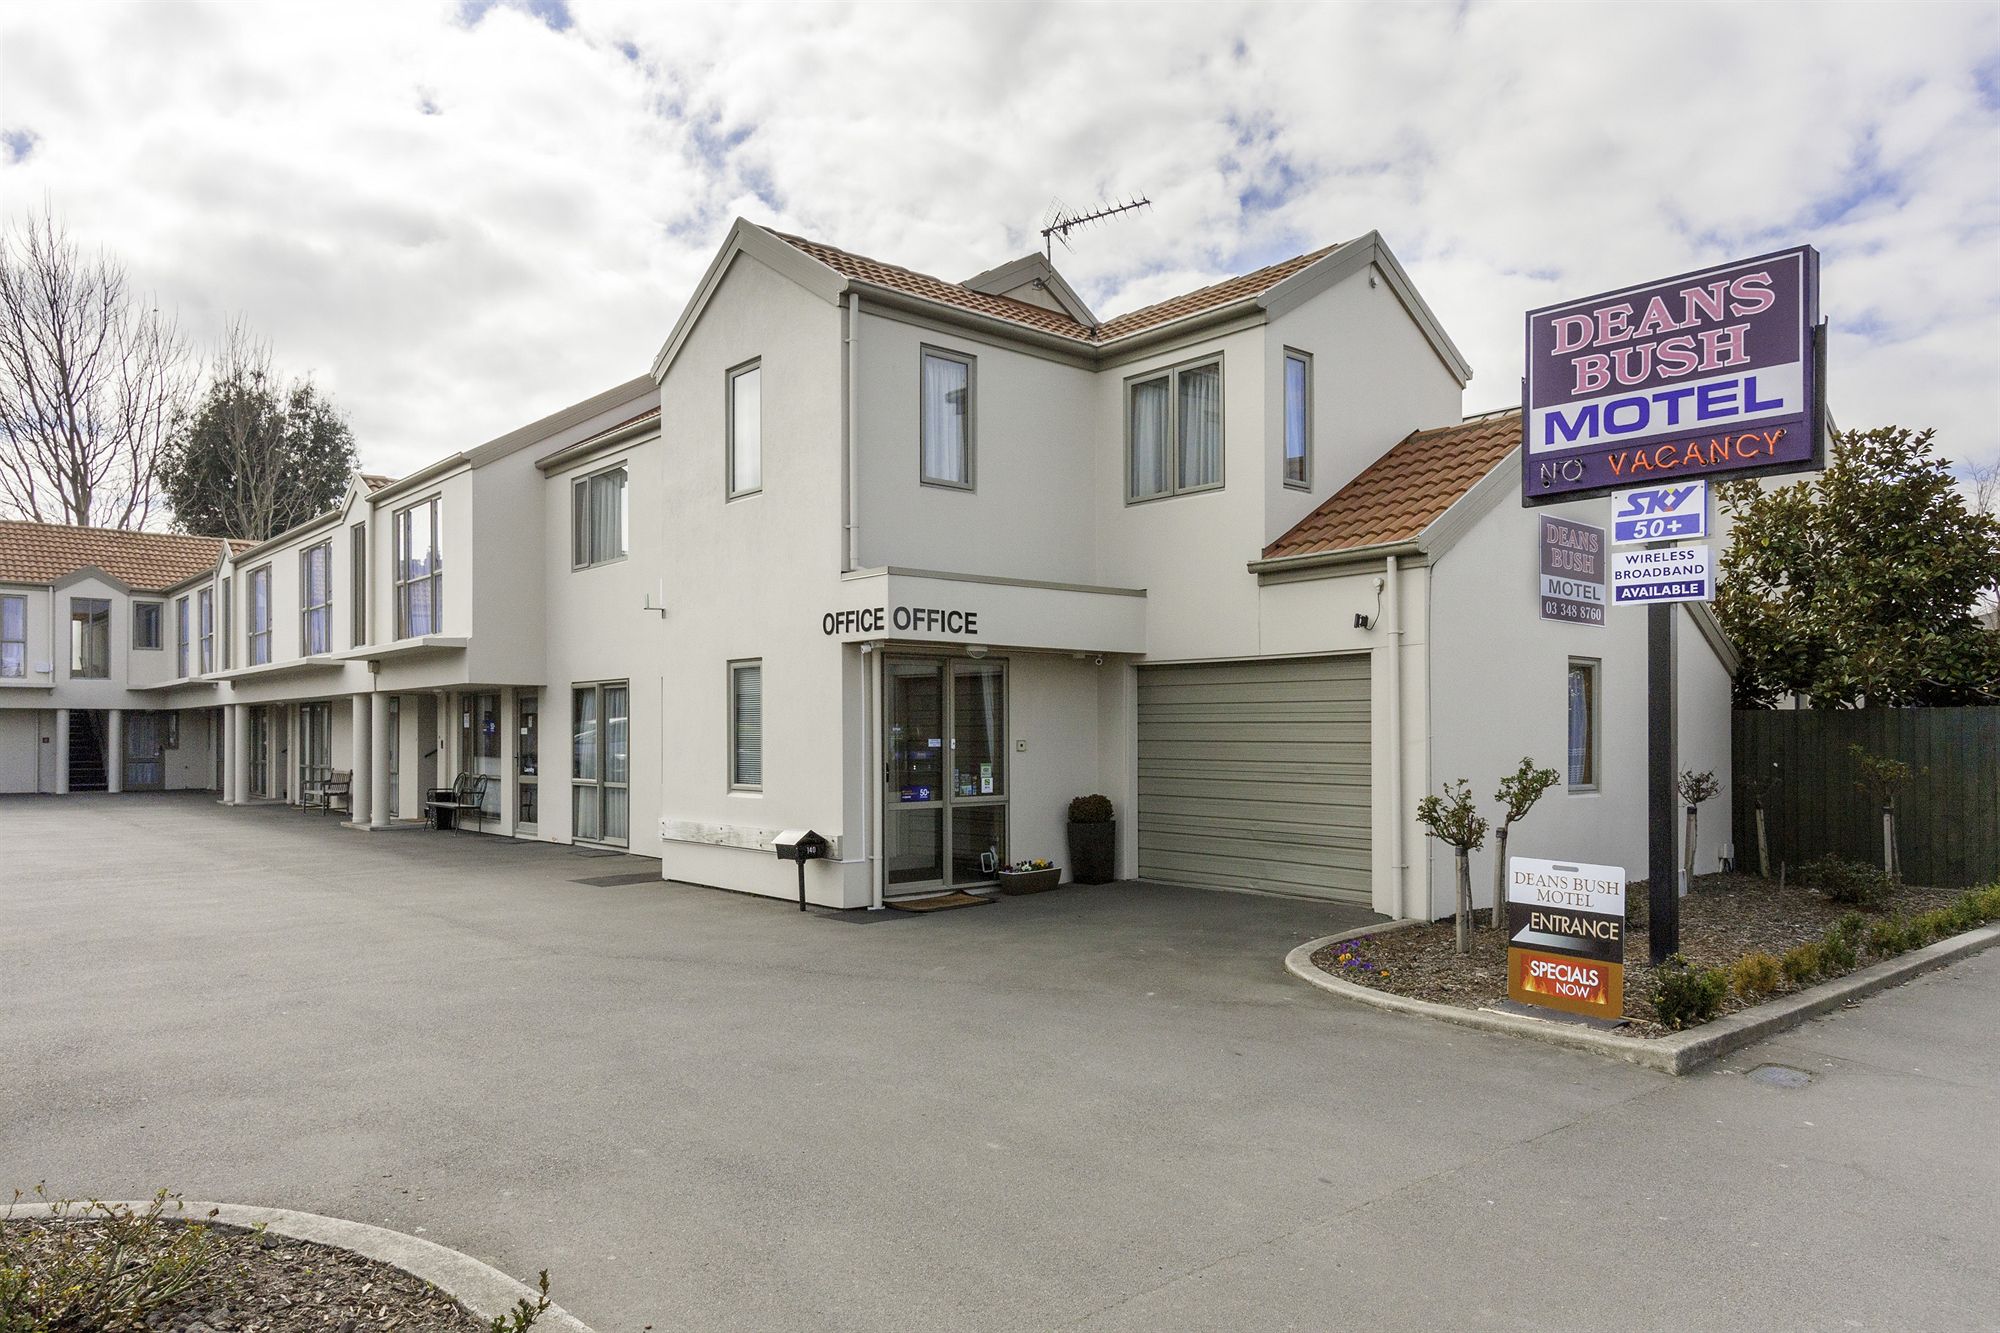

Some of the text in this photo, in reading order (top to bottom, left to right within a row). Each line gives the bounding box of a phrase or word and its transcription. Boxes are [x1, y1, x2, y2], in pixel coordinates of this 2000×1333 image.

[1551, 272, 1776, 356] DEANS
[1571, 323, 1751, 395] BUSH
[1545, 375, 1784, 446] MOTEL
[1540, 430, 1784, 485] NO VACANCY
[1617, 485, 1698, 518] SKY
[1546, 523, 1599, 553] DEANS
[1633, 519, 1682, 539] 50+
[1551, 547, 1595, 575] BUSH
[1625, 550, 1695, 565] WIRELESS
[1614, 564, 1705, 580] BROADBAND
[1548, 579, 1601, 601] MOTEL
[1621, 583, 1699, 599] AVAILABLE
[822, 607, 885, 636] OFFICE
[892, 606, 978, 635] OFFICE
[1545, 601, 1601, 621] 03 348 8760
[1514, 871, 1620, 896] DEANS BUSH
[1536, 889, 1595, 908] MOTEL
[1530, 912, 1619, 941] ENTRANCE
[1530, 960, 1599, 987] SPECIALS
[1555, 982, 1590, 999] NOW
